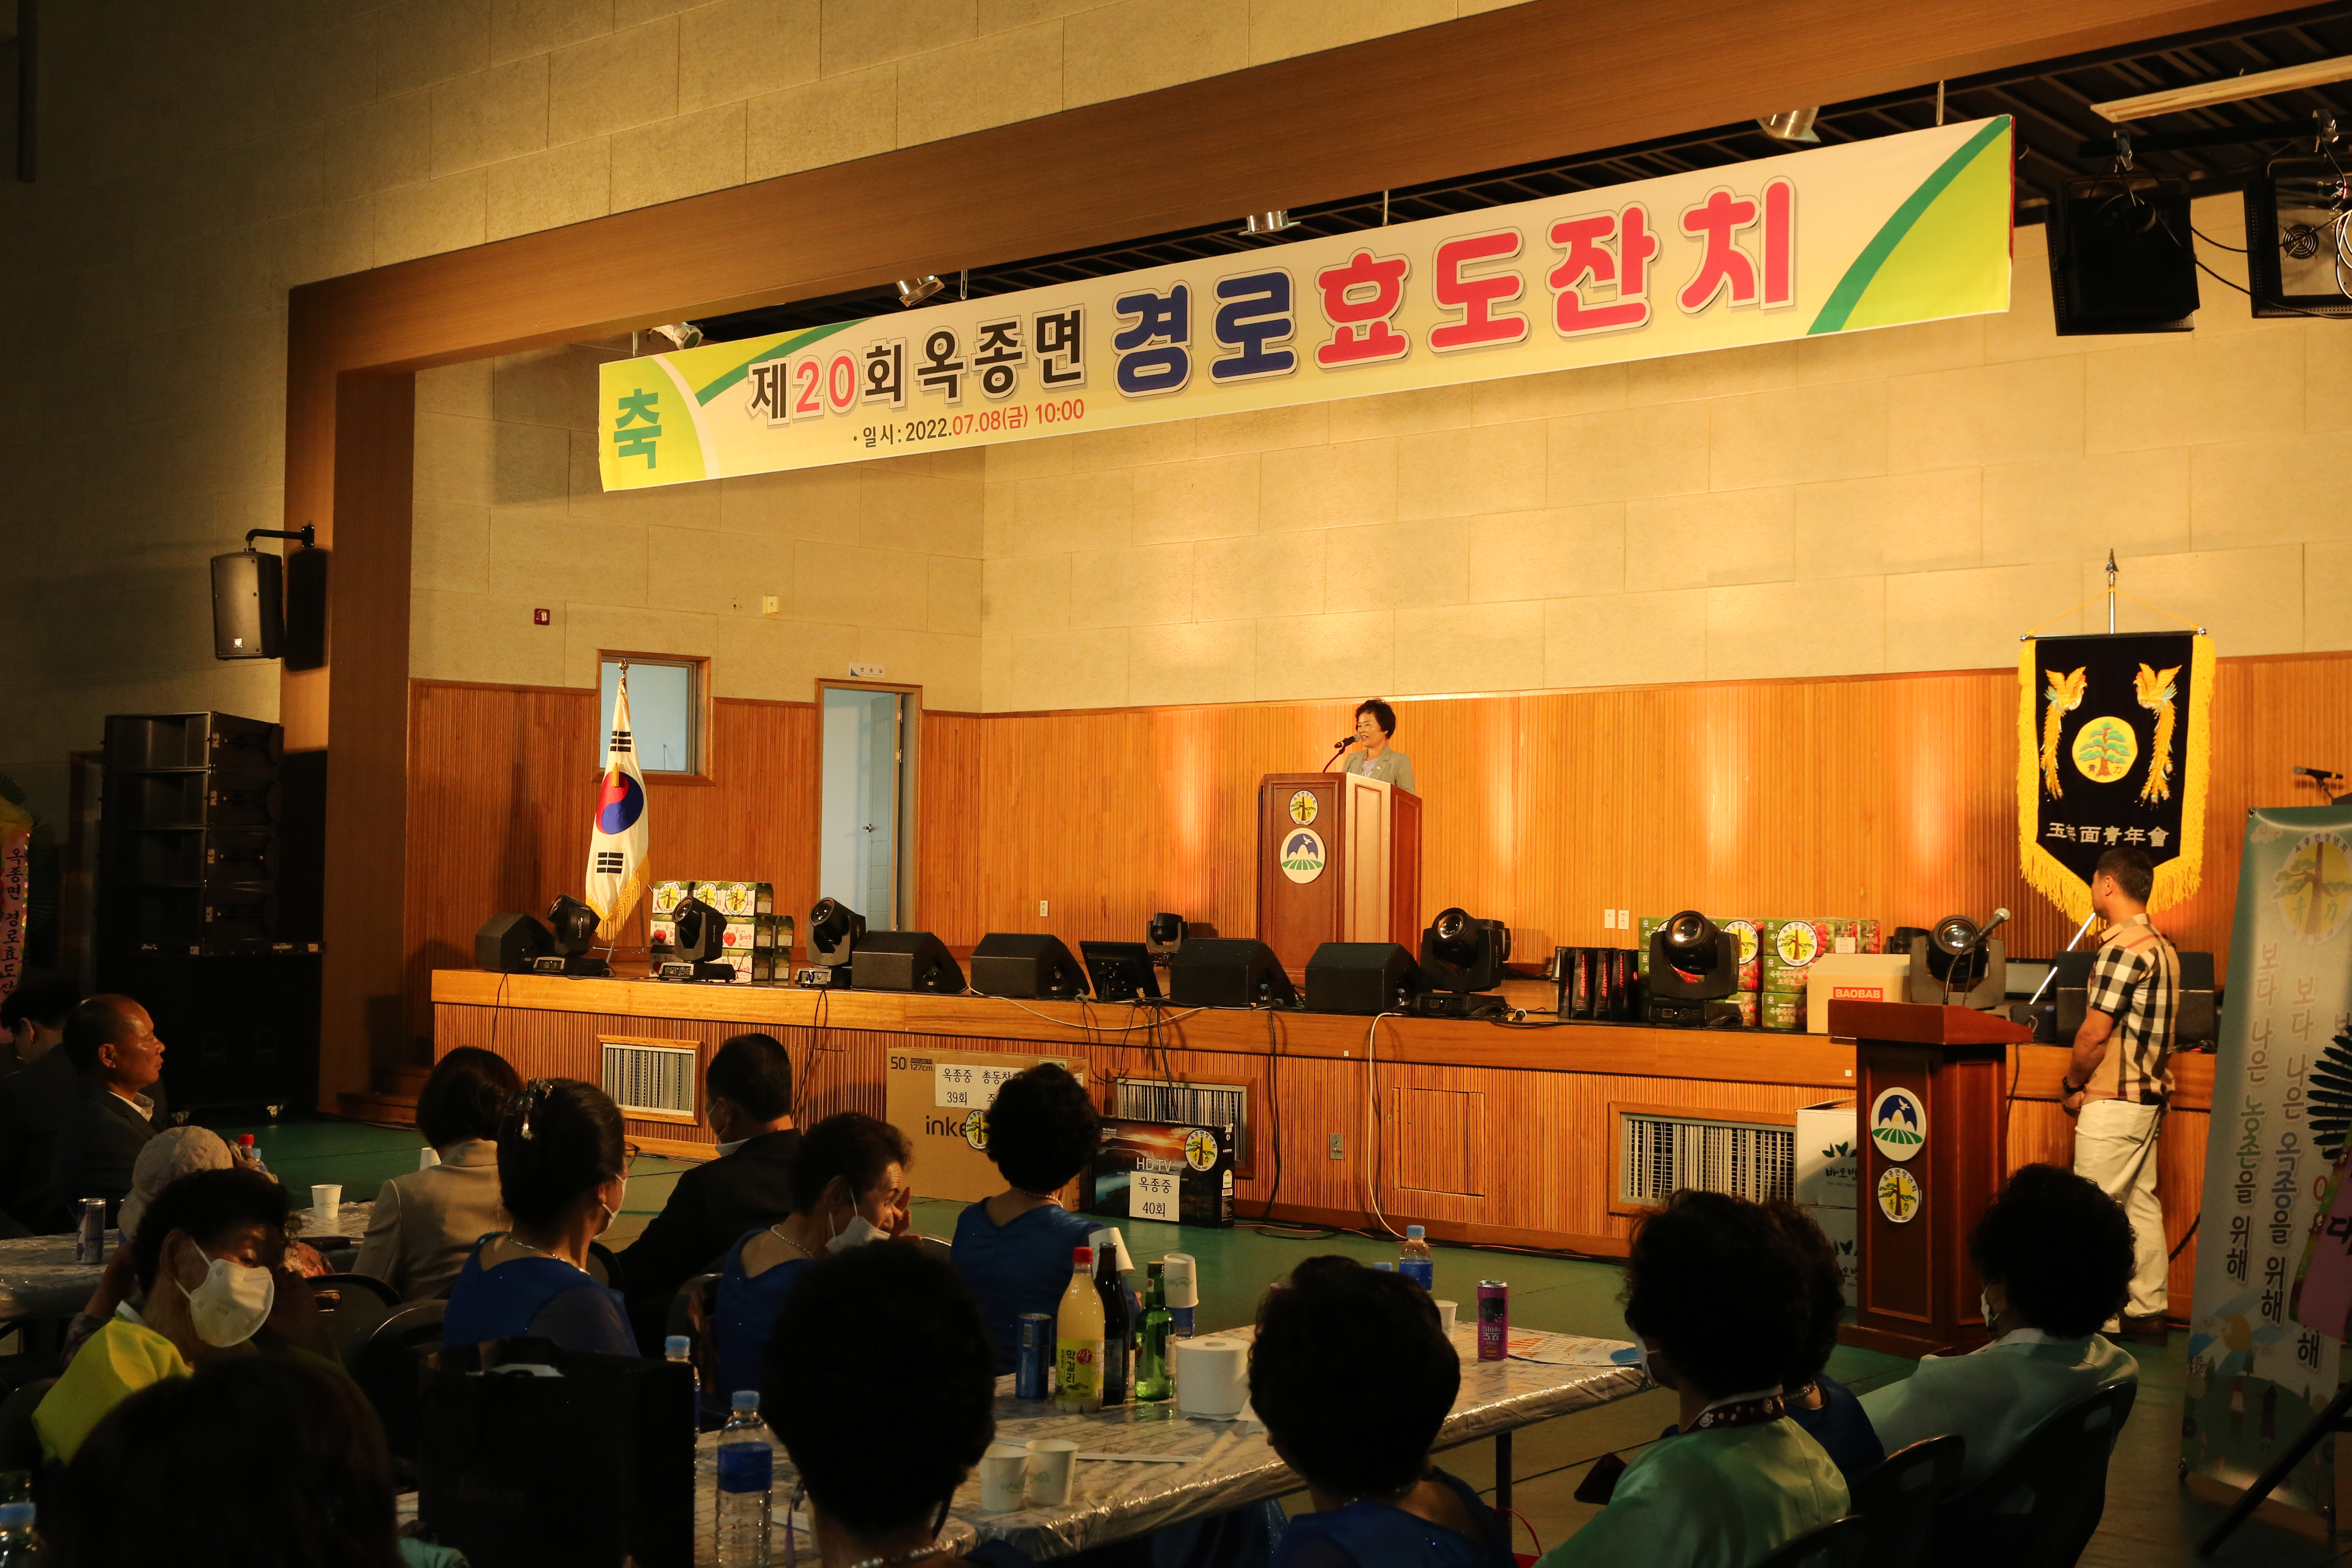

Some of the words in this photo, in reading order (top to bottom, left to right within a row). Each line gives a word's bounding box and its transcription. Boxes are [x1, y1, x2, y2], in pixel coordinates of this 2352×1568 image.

[1036, 399, 1084, 425] 10:00
[614, 388, 662, 470] 축
[6, 848, 25, 900] 옥종면
[1782, 922, 1815, 941] 옥종면청년회
[0, 910, 20, 994] 경로효도잔
[2256, 942, 2279, 1005] 보다
[1835, 989, 1881, 999] BAOBAB
[2292, 976, 2315, 1041] 보다
[891, 1056, 906, 1070] 50
[2247, 1018, 2273, 1082] 나은
[942, 1068, 973, 1083] 옥종중
[2282, 1054, 2309, 1120] 나은
[947, 1091, 967, 1106] 39회
[1190, 1131, 1216, 1149] 옥종면청년회
[1138, 1177, 1172, 1194] 옥종중
[1883, 1169, 1917, 1192] 옥종면청년회
[2269, 1131, 2302, 1244] 옥종을
[1143, 1202, 1166, 1218] 40회
[2226, 1215, 2252, 1281] 위해
[2261, 1256, 2286, 1324] 위해
[1066, 1350, 1076, 1383] 막걸리
[1078, 1350, 1092, 1364] 쌀
